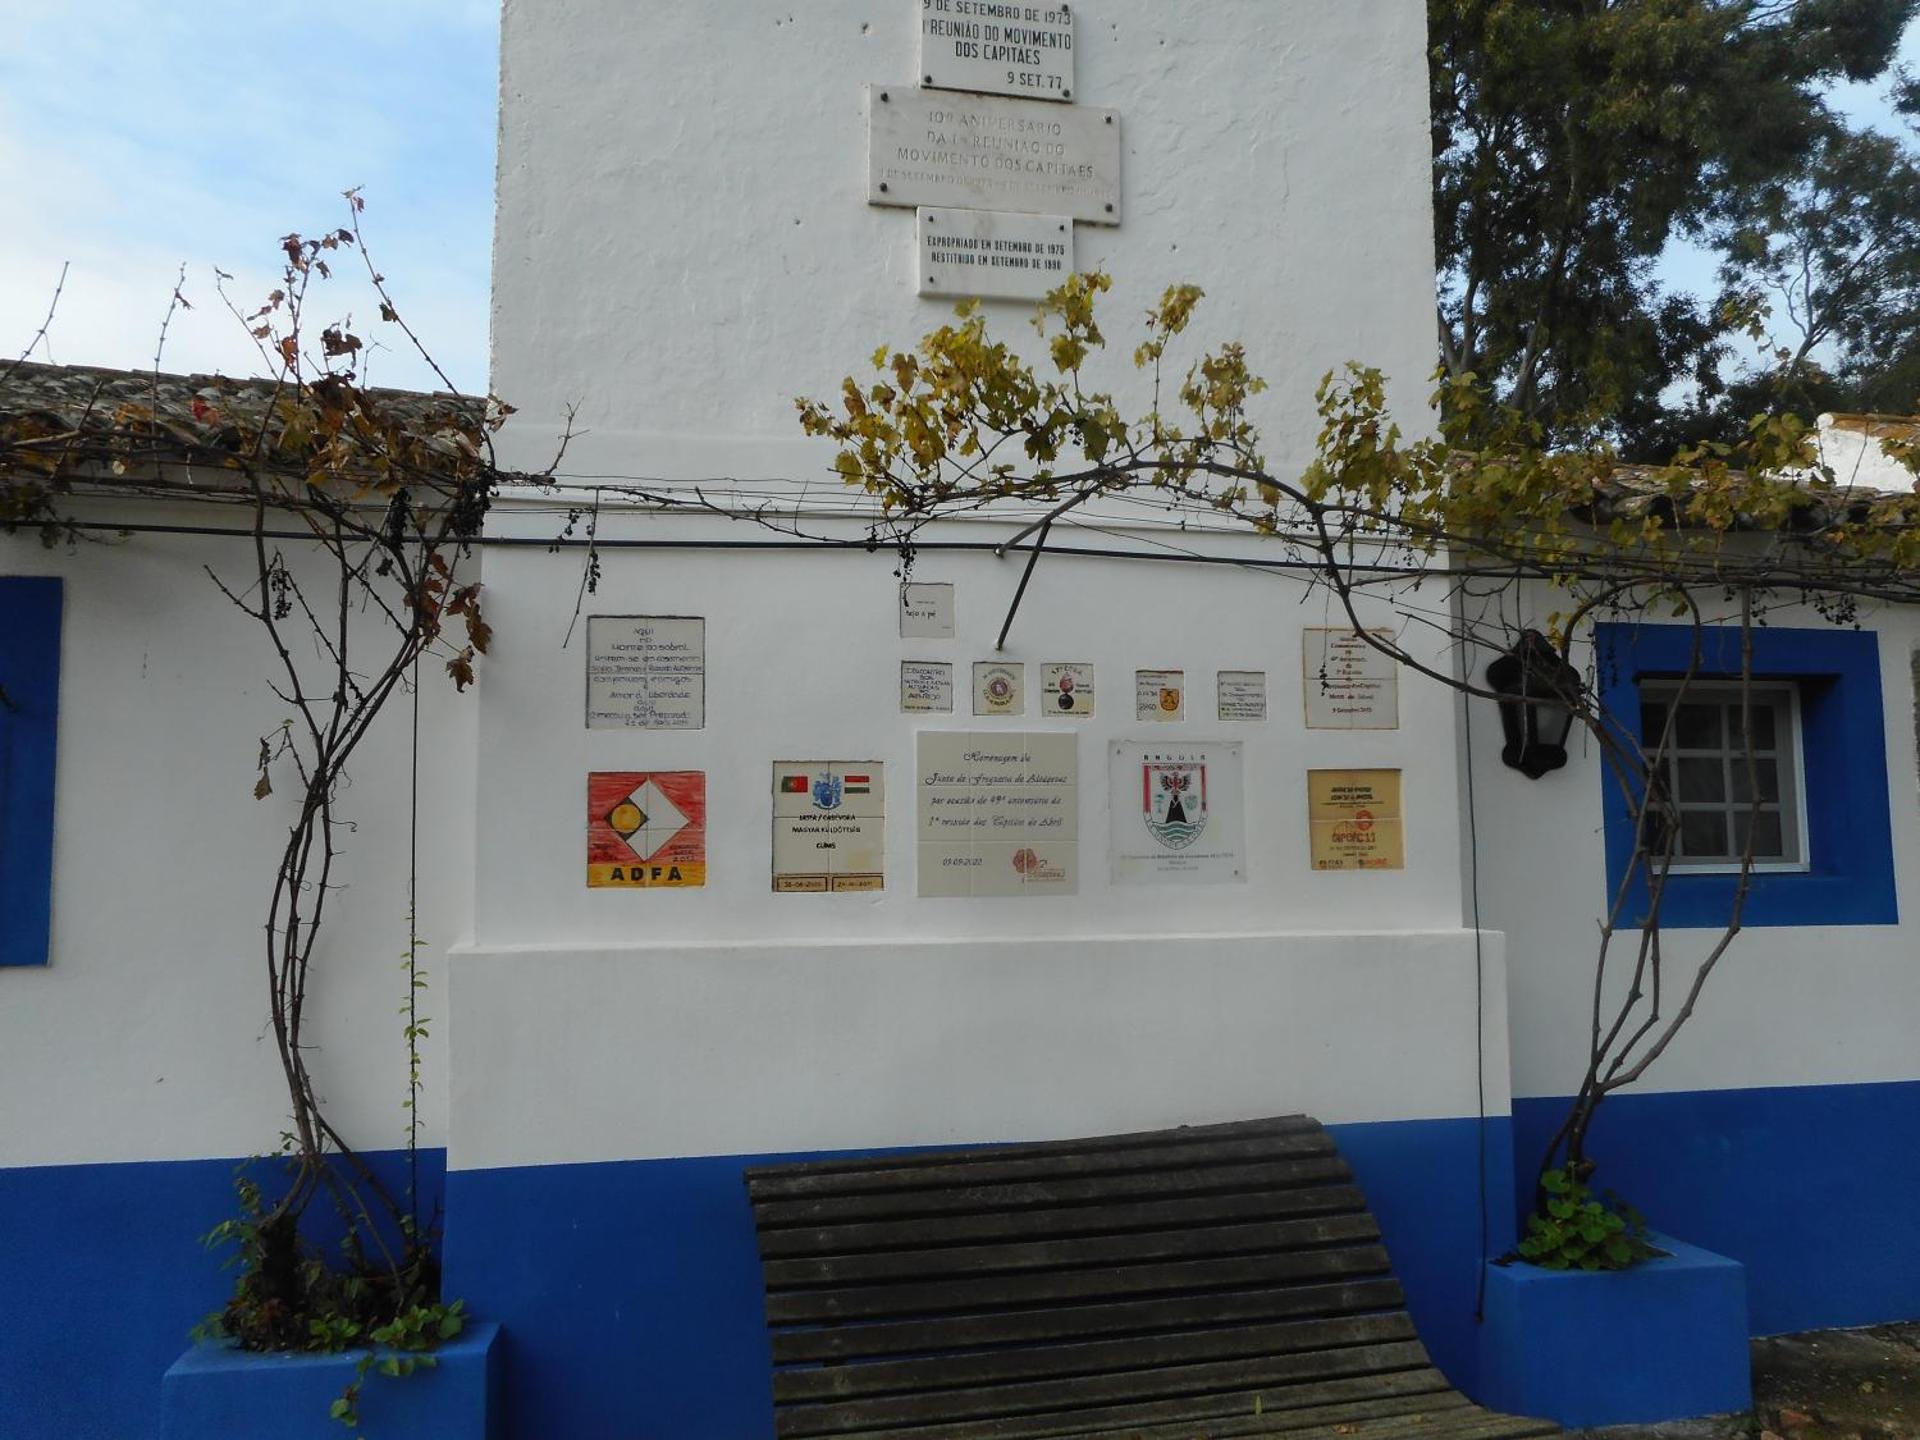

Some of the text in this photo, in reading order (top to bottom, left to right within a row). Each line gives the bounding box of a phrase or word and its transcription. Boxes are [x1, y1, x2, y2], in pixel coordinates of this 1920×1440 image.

[936, 0, 950, 11] DE
[956, 1, 1020, 19] SETEMBRO
[1024, 8, 1040, 22] DE
[1044, 11, 1071, 25] 1973
[984, 25, 1000, 42] DO
[1004, 27, 1071, 50] MOVIMENTO
[955, 41, 978, 58] DOS
[1007, 71, 1062, 90] 9 SET. 77
[898, 147, 990, 169] MOVIMENTO
[995, 154, 1022, 172] DOS
[981, 239, 992, 249] EM
[995, 240, 1032, 252] SETEMBRO
[1035, 243, 1045, 254] DE
[978, 254, 988, 266] EM
[991, 255, 1029, 268] SETEMBRO
[1032, 258, 1041, 269] DE
[610, 866, 683, 881] ADFA
